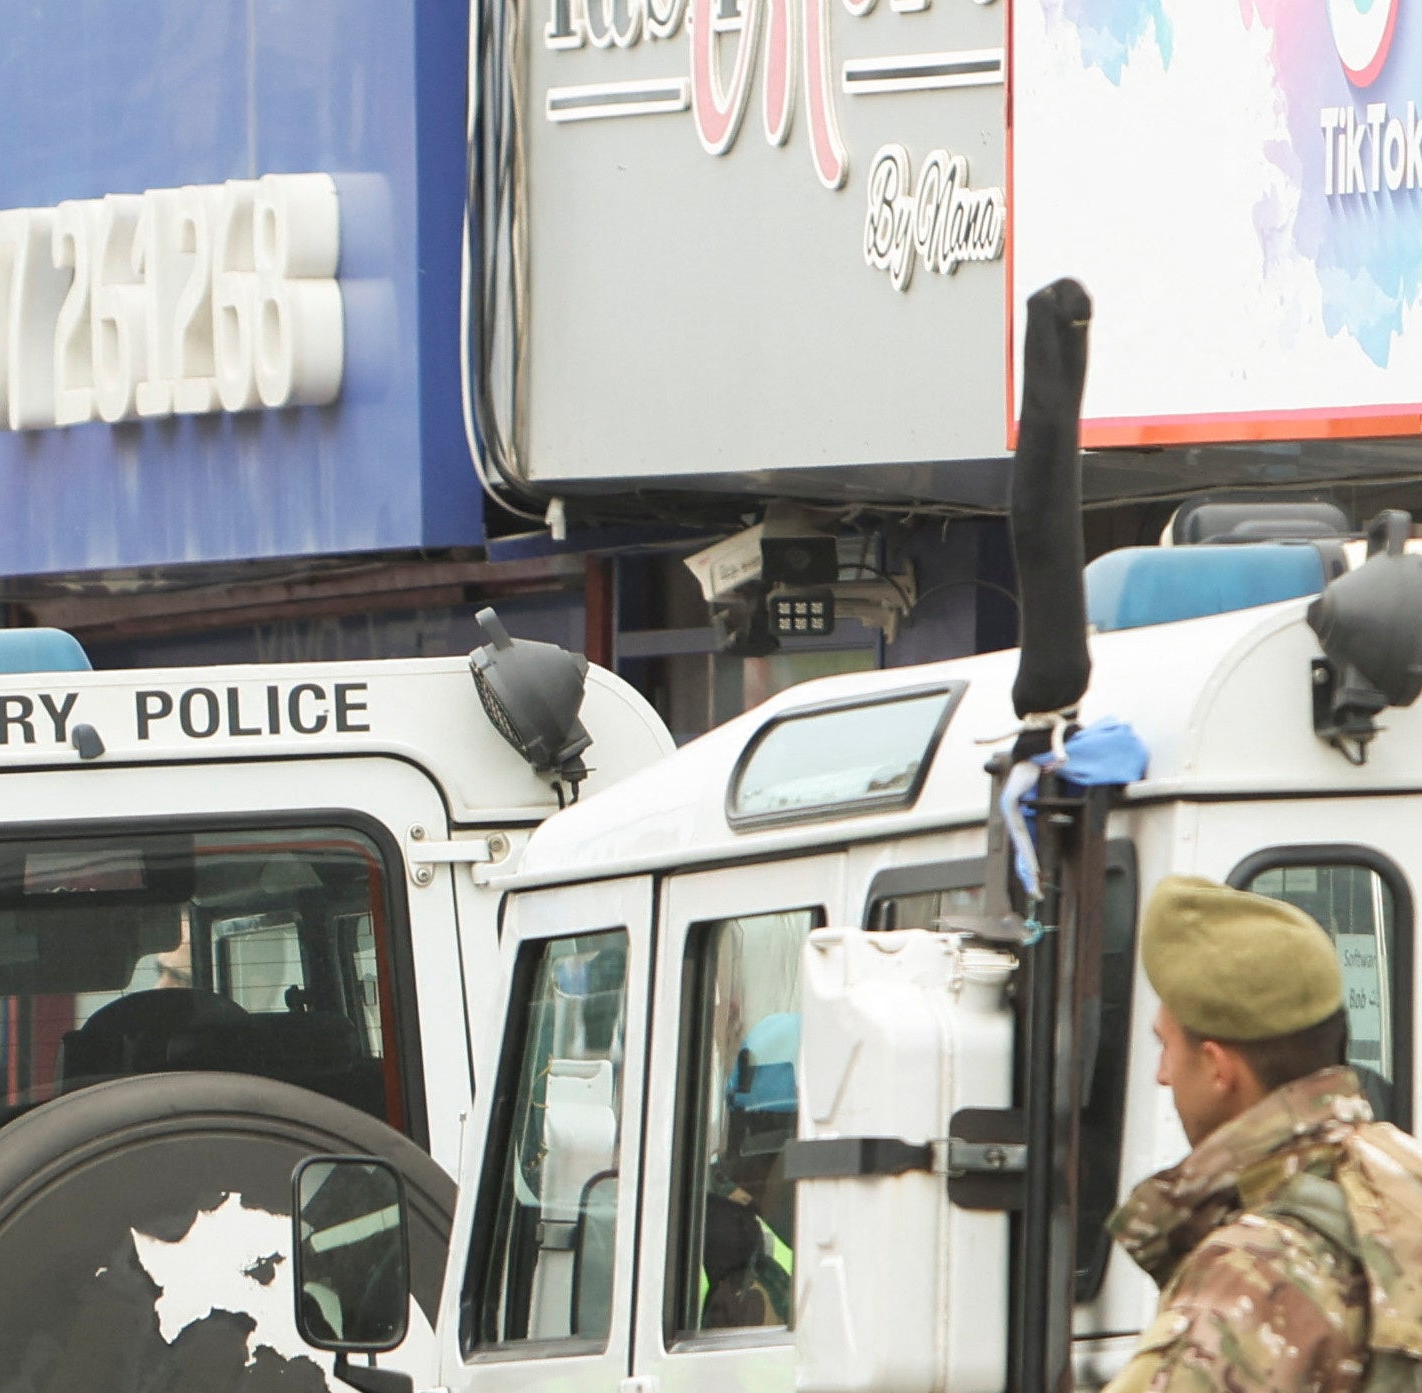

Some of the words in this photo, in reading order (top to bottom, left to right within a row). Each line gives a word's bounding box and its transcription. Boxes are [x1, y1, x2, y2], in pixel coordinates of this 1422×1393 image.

[866, 148, 913, 287] By
[916, 154, 1002, 268] Nana
[135, 682, 372, 741] POLICE
